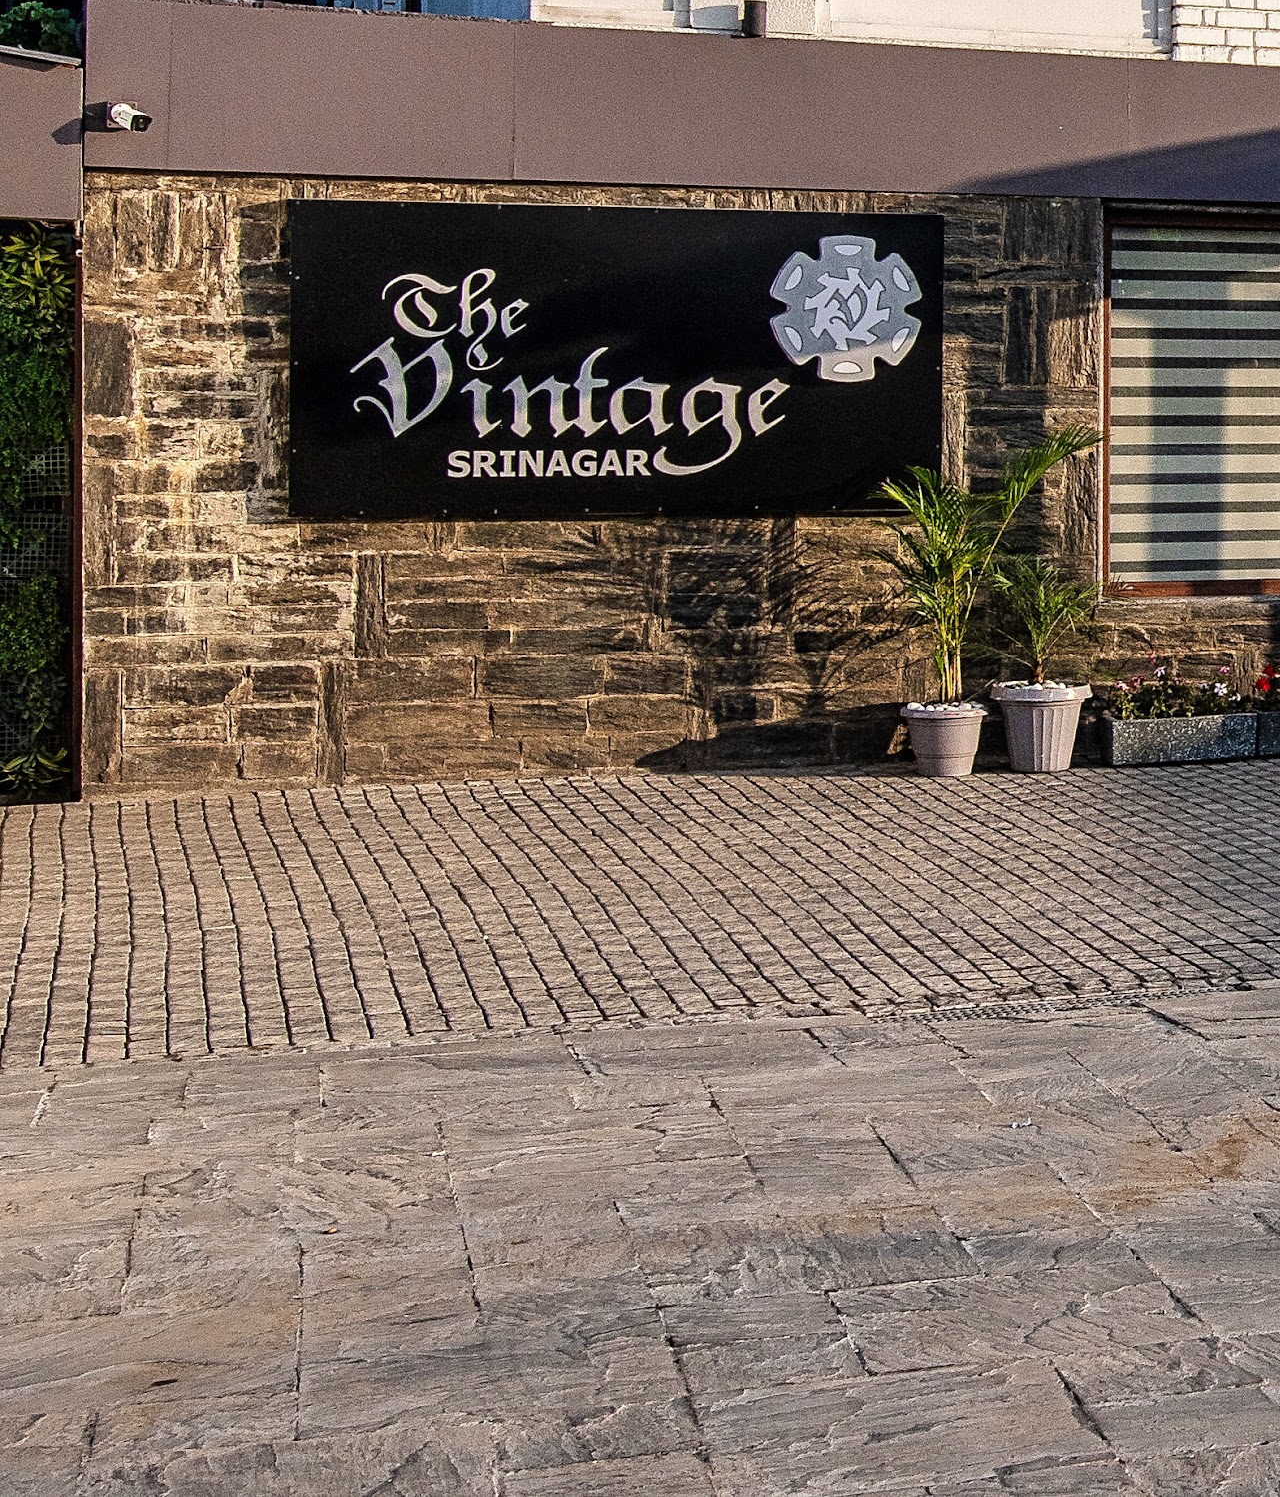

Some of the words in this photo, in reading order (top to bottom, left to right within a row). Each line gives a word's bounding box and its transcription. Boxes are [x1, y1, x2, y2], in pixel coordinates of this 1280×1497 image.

[381, 268, 530, 370] The
[349, 336, 790, 476] Vintage
[447, 449, 652, 478] SRINAGAR
